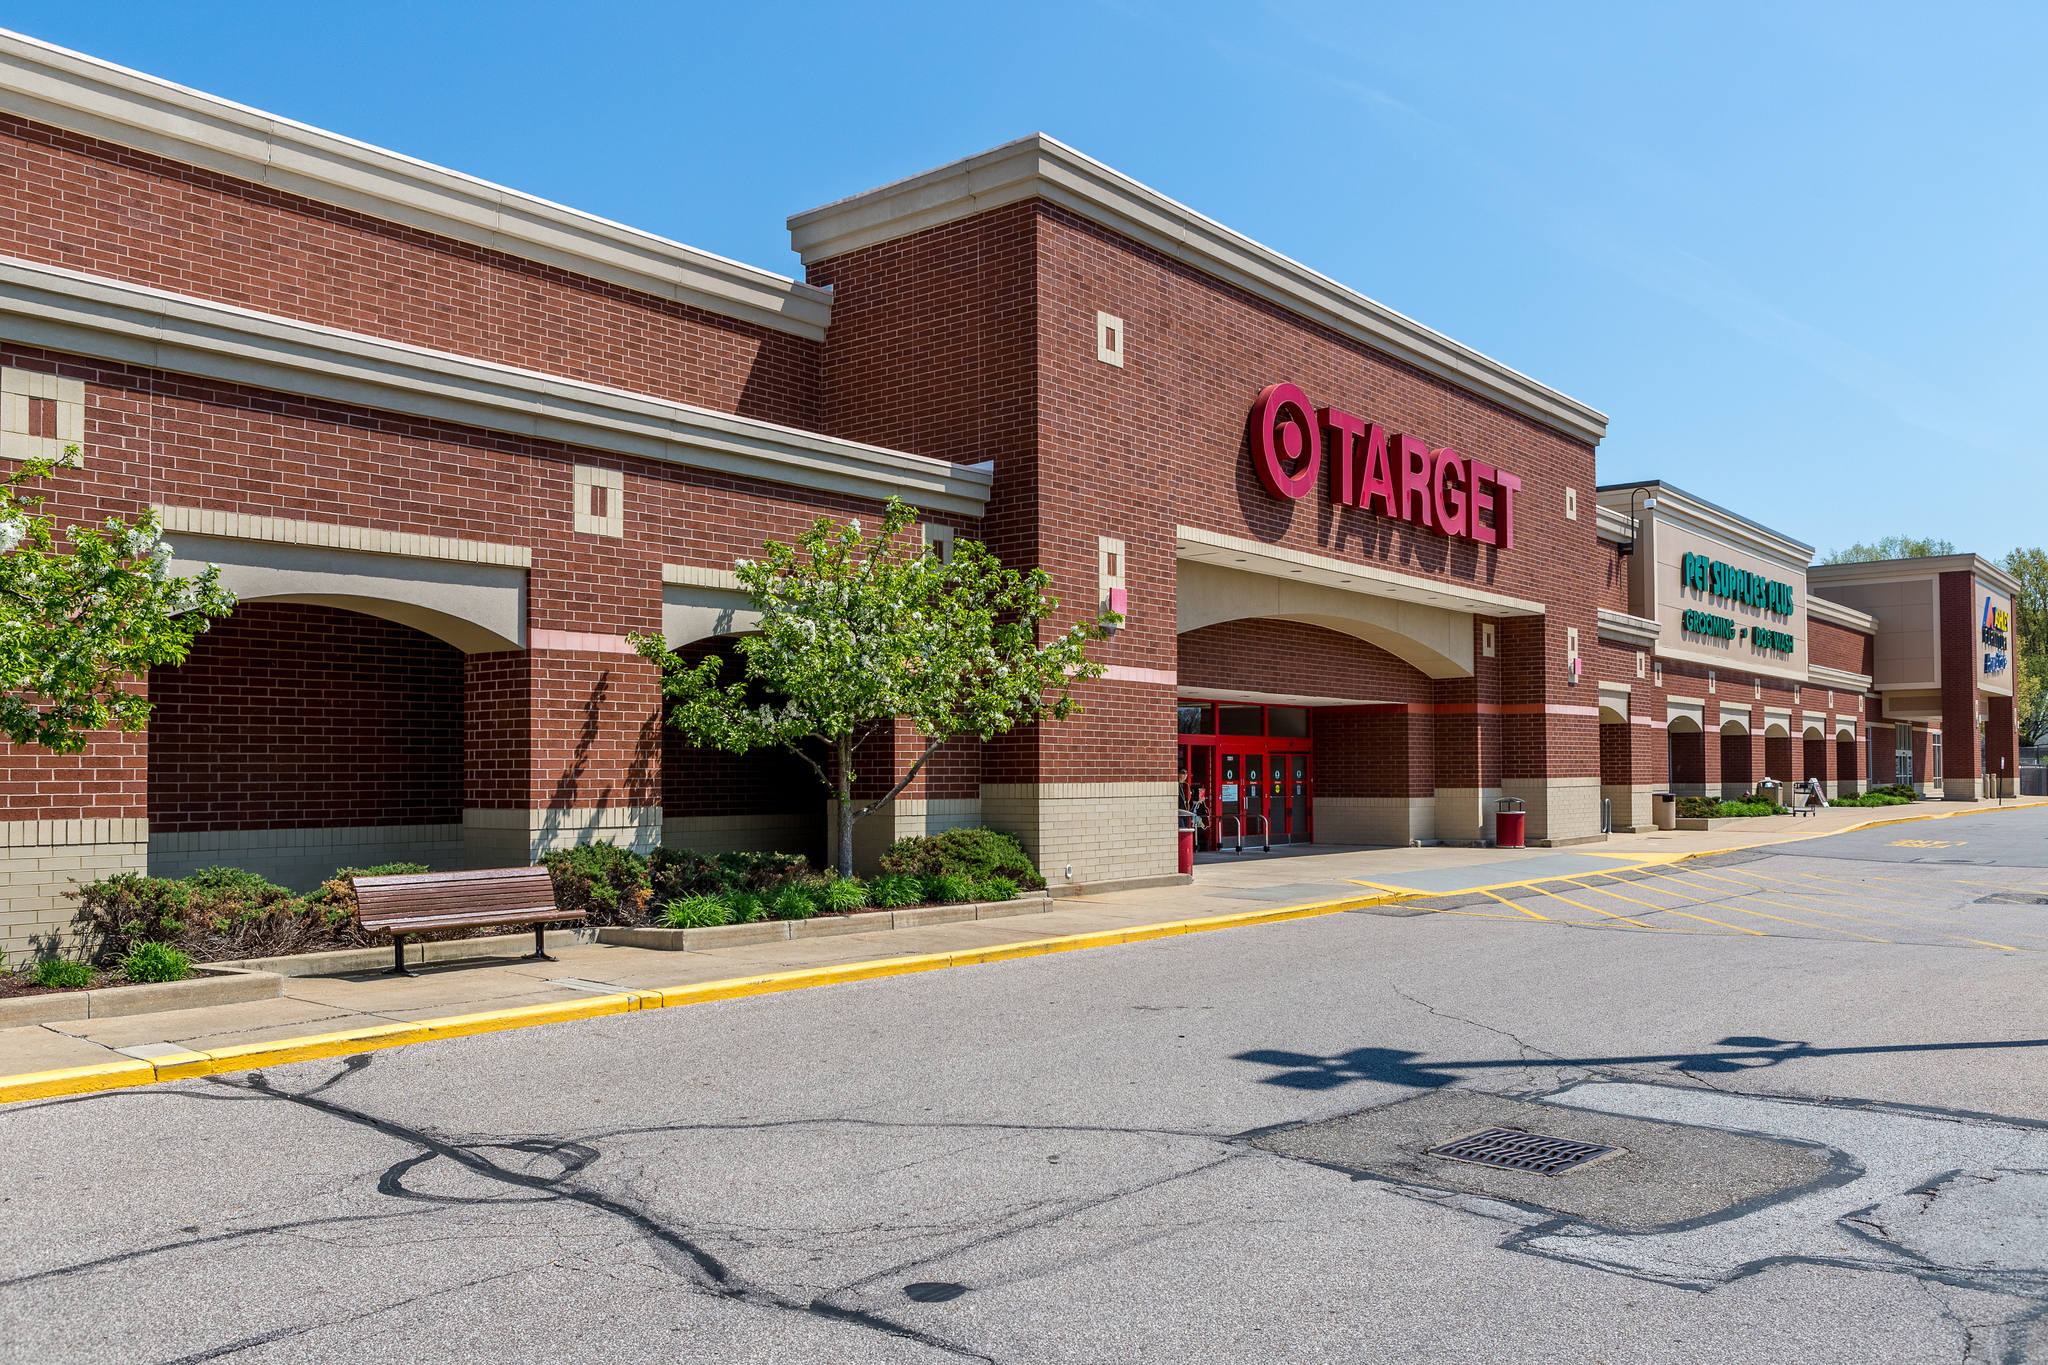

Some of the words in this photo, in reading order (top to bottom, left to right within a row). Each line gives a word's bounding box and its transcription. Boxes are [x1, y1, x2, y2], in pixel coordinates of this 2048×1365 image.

[1318, 405, 1522, 549] TARGET
[1684, 551, 1710, 592] PET
[1712, 560, 1766, 608] SUPPLIES
[1768, 579, 1794, 616] PLUS
[1684, 608, 1736, 640] GROOMING
[1754, 626, 1772, 648] DOG
[1773, 631, 1794, 653] WASH
